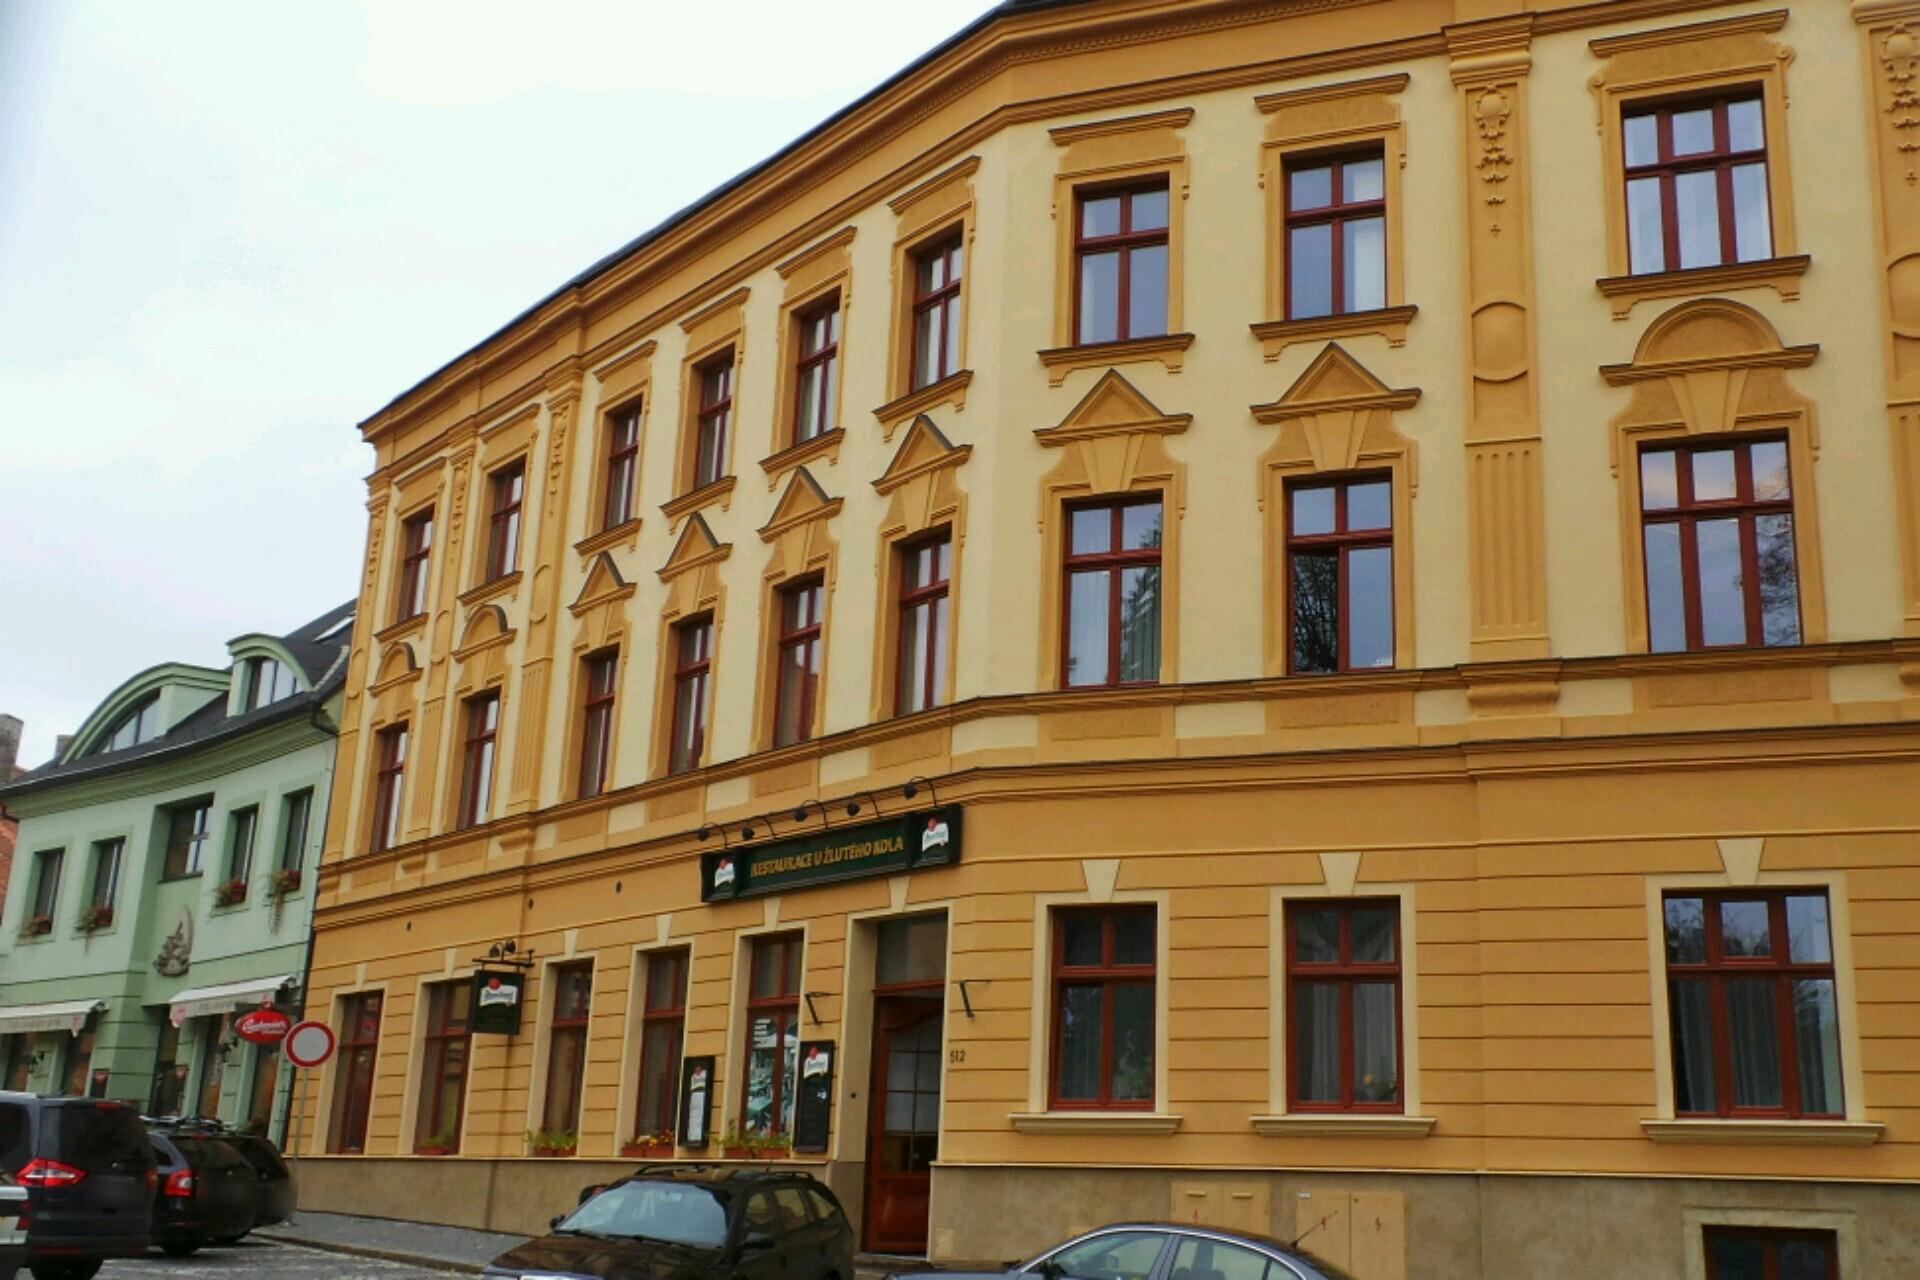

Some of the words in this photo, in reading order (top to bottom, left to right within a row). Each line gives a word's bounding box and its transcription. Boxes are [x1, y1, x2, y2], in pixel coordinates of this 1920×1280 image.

[751, 853, 813, 877] RESTAURACE
[814, 852, 823, 866] U
[873, 836, 904, 856] KOLA
